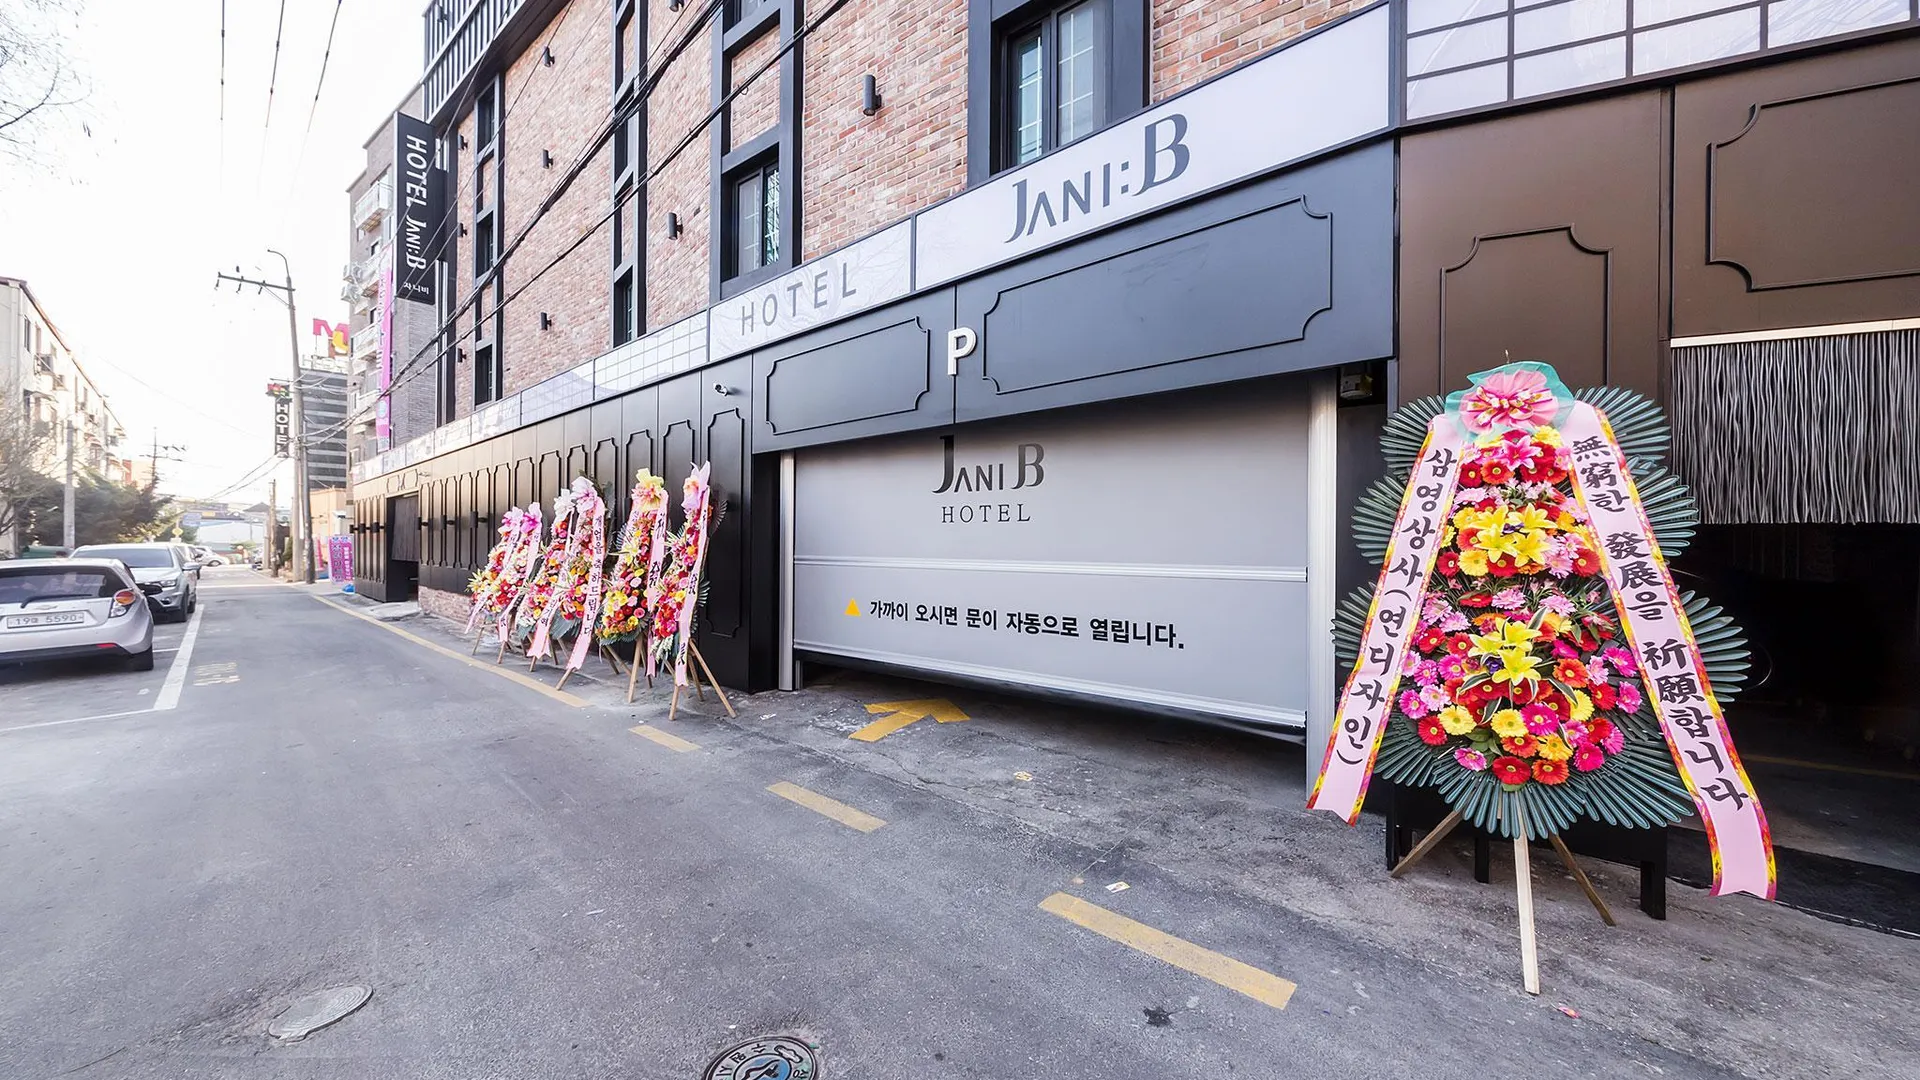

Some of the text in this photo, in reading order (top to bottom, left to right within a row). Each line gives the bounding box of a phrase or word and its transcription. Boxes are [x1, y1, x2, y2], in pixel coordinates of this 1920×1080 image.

[406, 134, 427, 270] HOTEL JANI:B
[1004, 113, 1190, 244] JANI:B
[403, 281, 430, 295] 자니비
[740, 261, 858, 338] HOTEL
[947, 327, 977, 376] P
[931, 434, 1045, 495] JANI B
[941, 503, 1031, 524] HOTEL
[45, 614, 77, 623] 5590
[870, 600, 1184, 649] 가까이 오시면 문이 자동으로 열립니다.
[1604, 530, 1669, 621] 發展을
[1642, 639, 1752, 812] 祈願합니다
